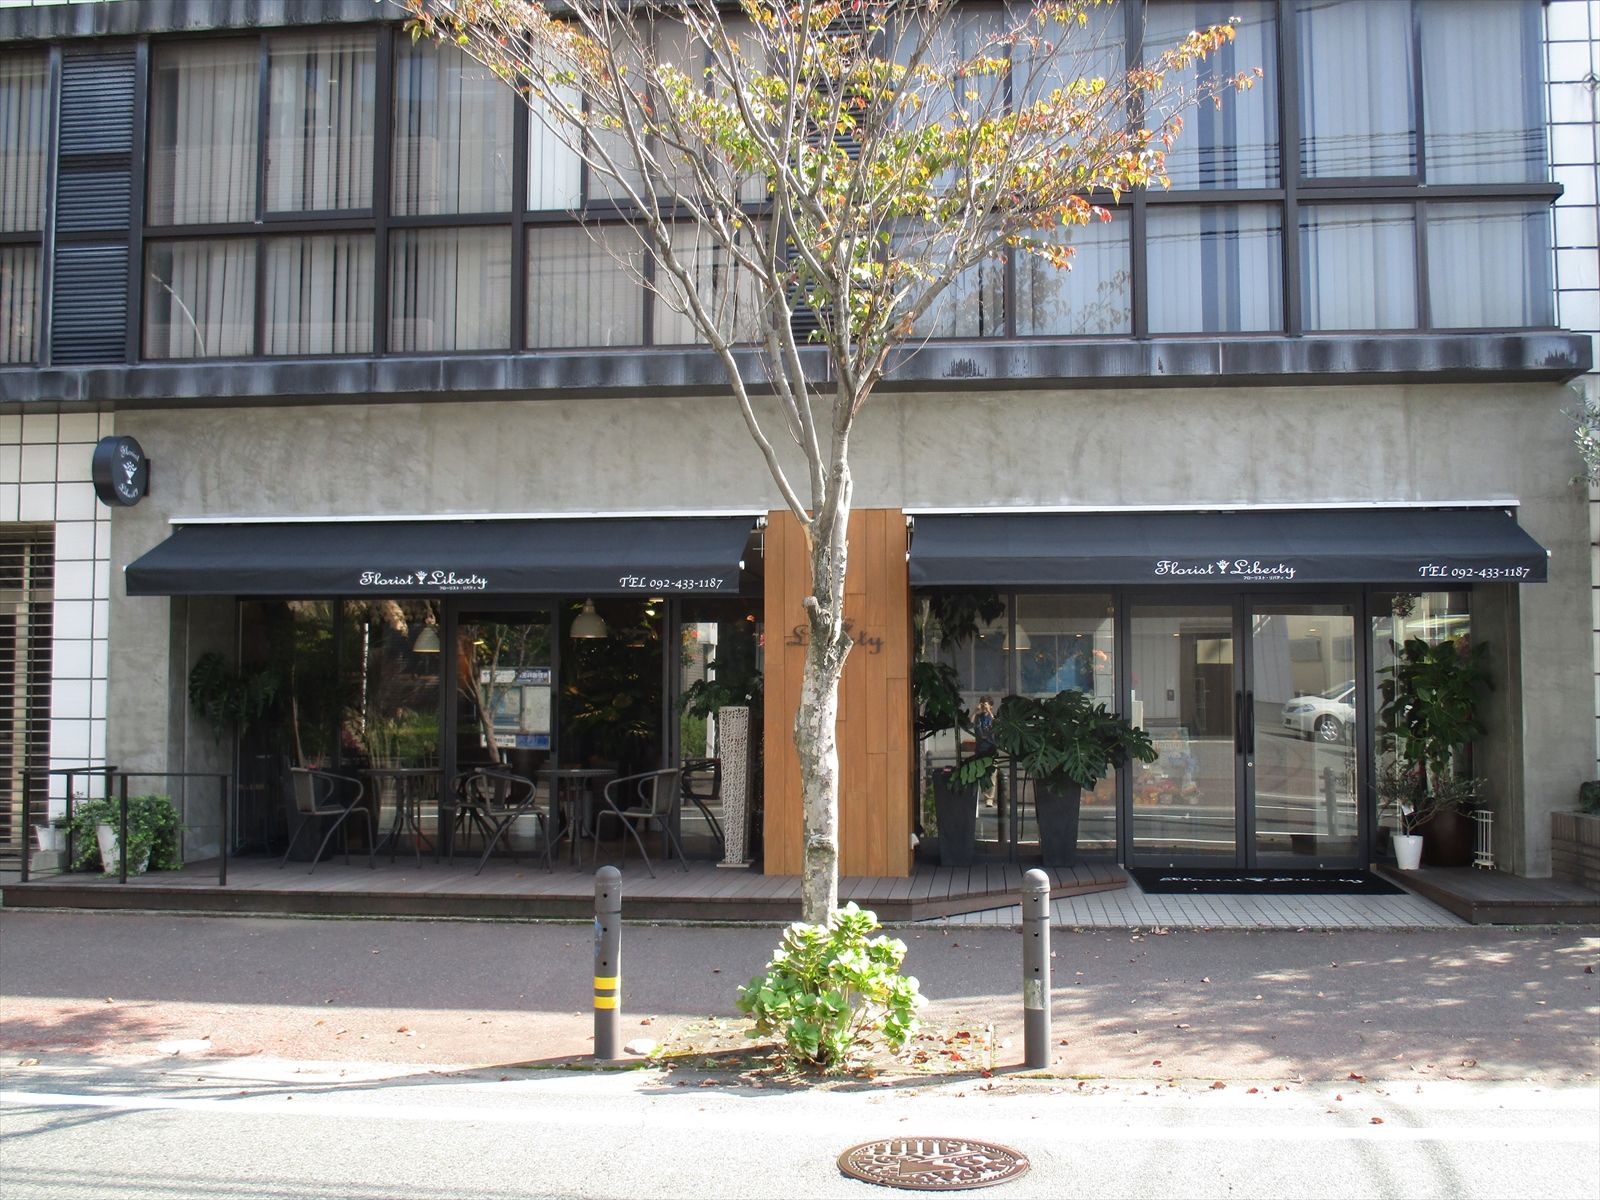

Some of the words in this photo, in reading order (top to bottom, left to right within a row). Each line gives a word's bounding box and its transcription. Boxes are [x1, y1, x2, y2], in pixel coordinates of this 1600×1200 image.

[1154, 560, 1214, 575] Florist
[1230, 559, 1296, 579] Liberty
[1418, 563, 1448, 577] TEL
[1451, 566, 1530, 579] 092-433-1187
[359, 571, 414, 586] Florist
[427, 570, 488, 590] Liberty
[619, 574, 647, 588] TEL
[649, 577, 724, 590] 092-433-1187
